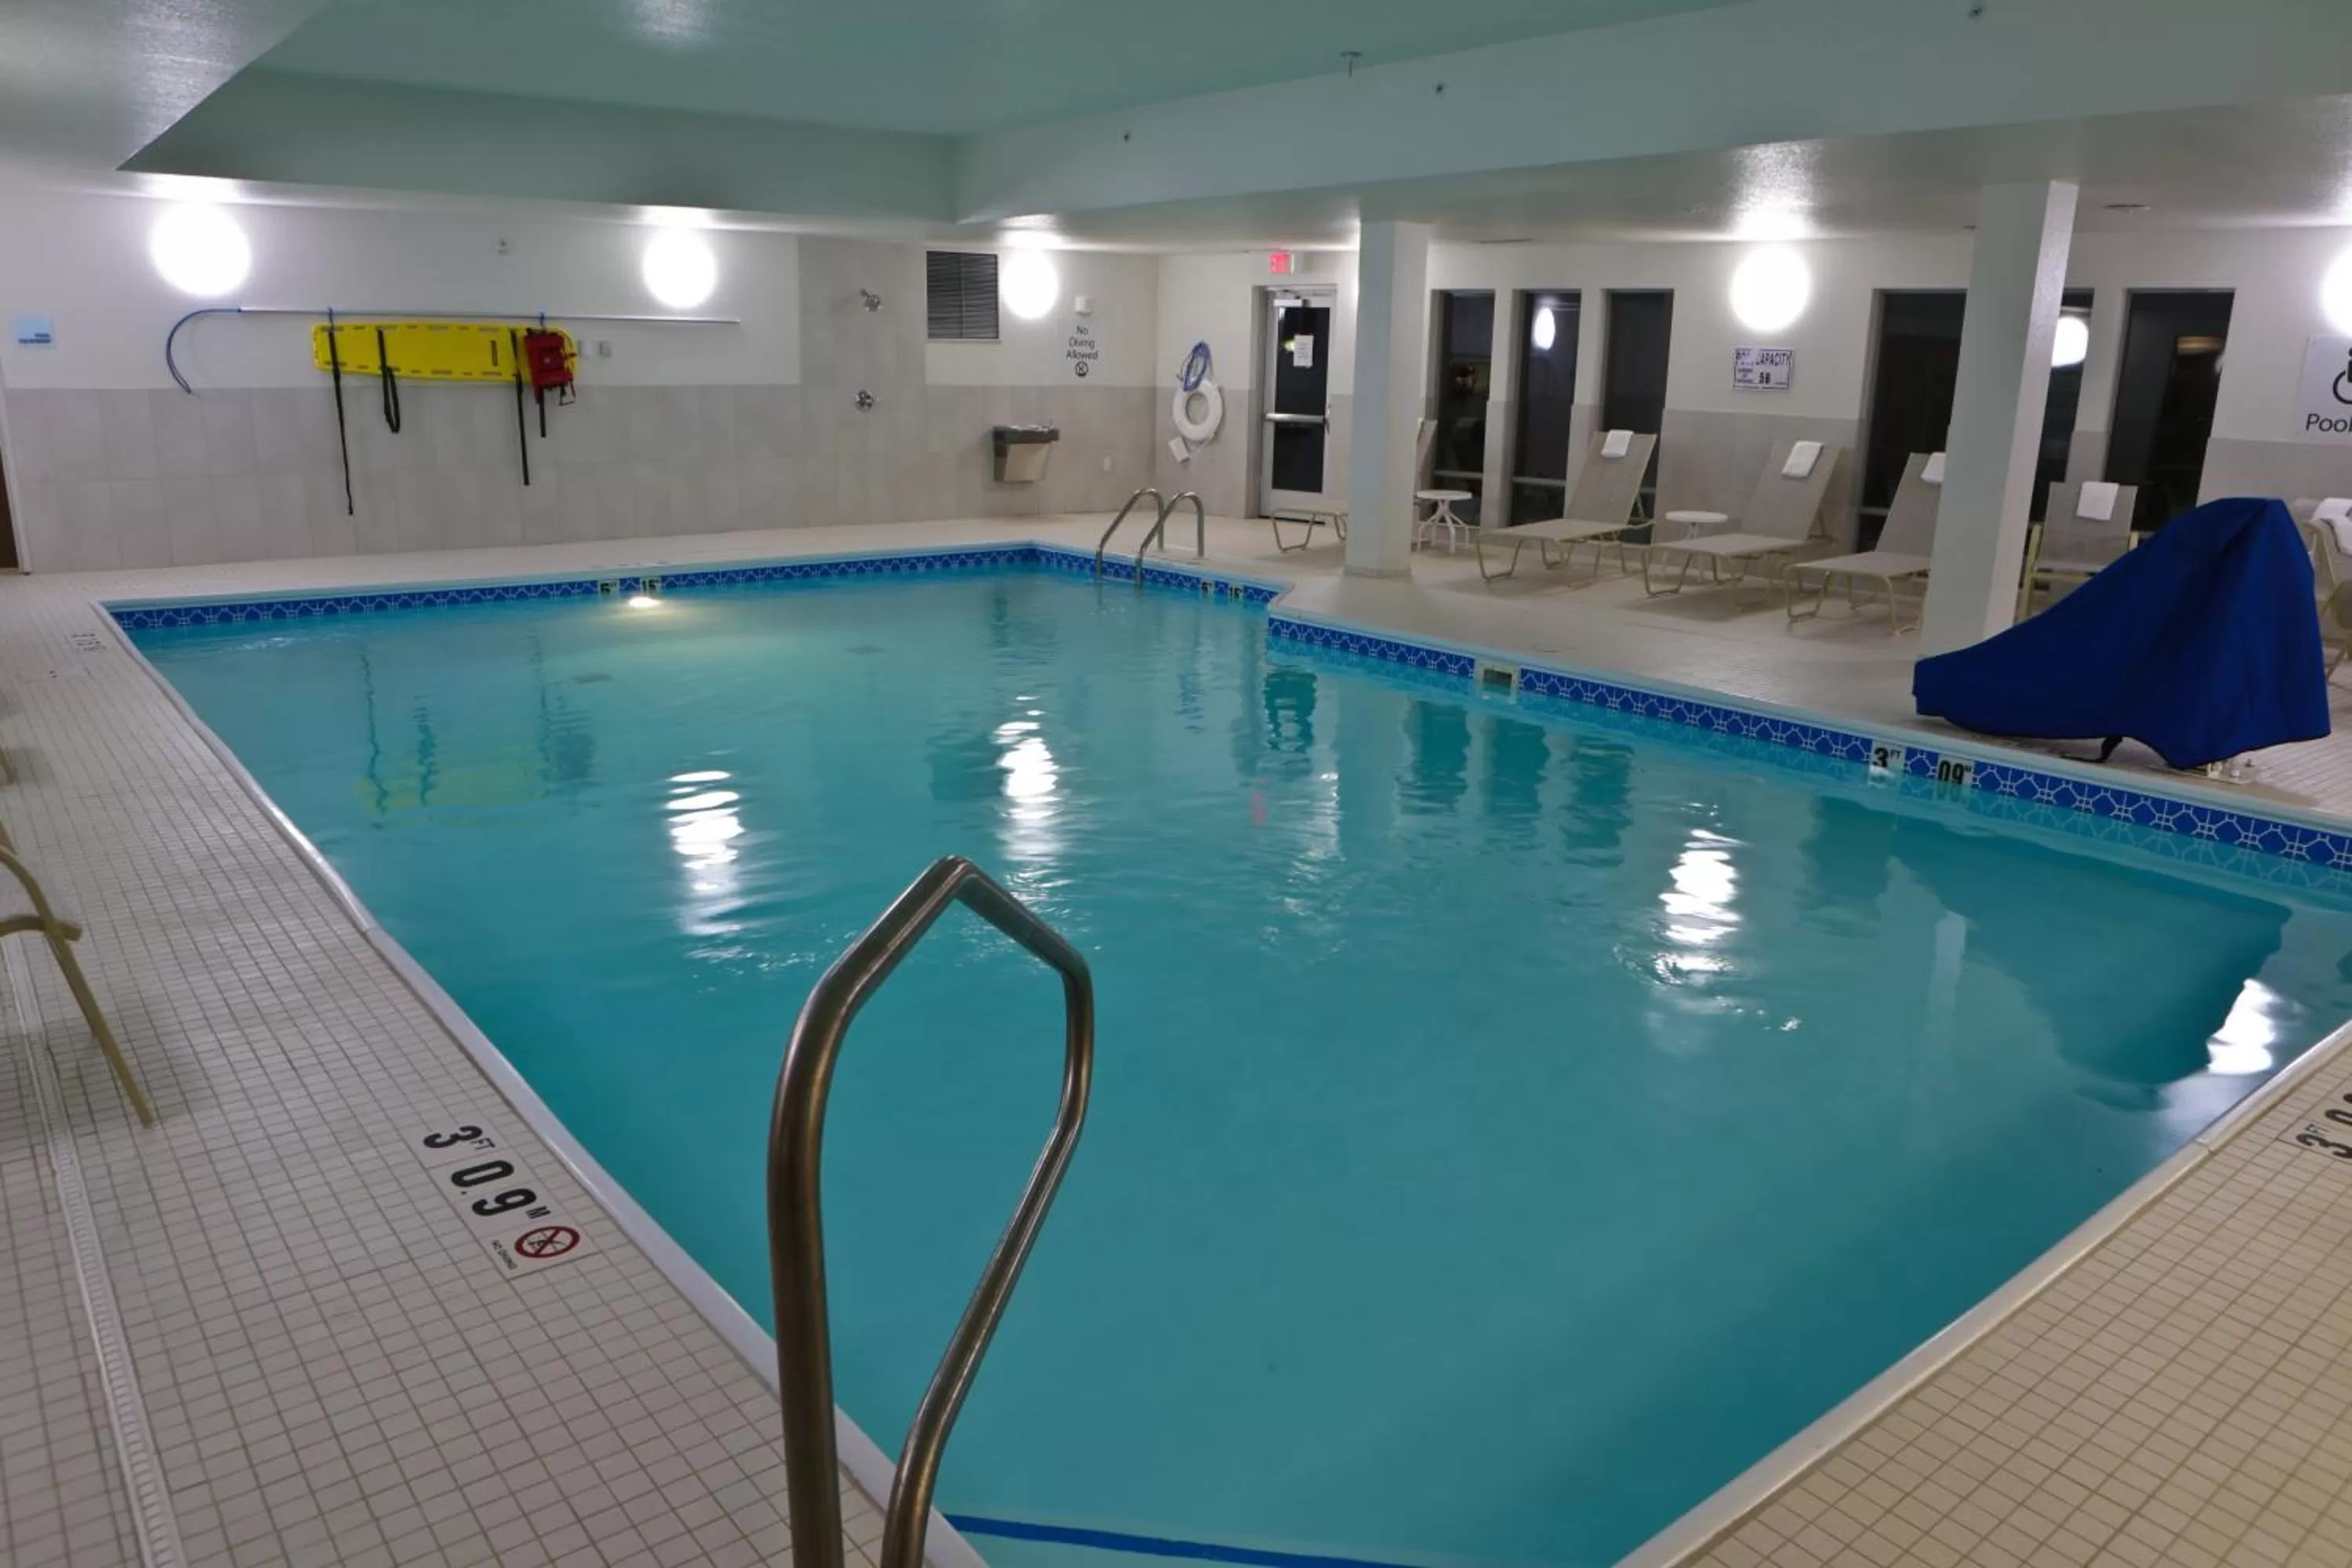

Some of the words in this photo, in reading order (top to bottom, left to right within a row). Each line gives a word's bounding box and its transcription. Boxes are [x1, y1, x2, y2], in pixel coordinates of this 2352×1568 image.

[1076, 325, 1090, 336] No
[1069, 336, 1095, 350] Diving
[1066, 350, 1098, 361] Allowed
